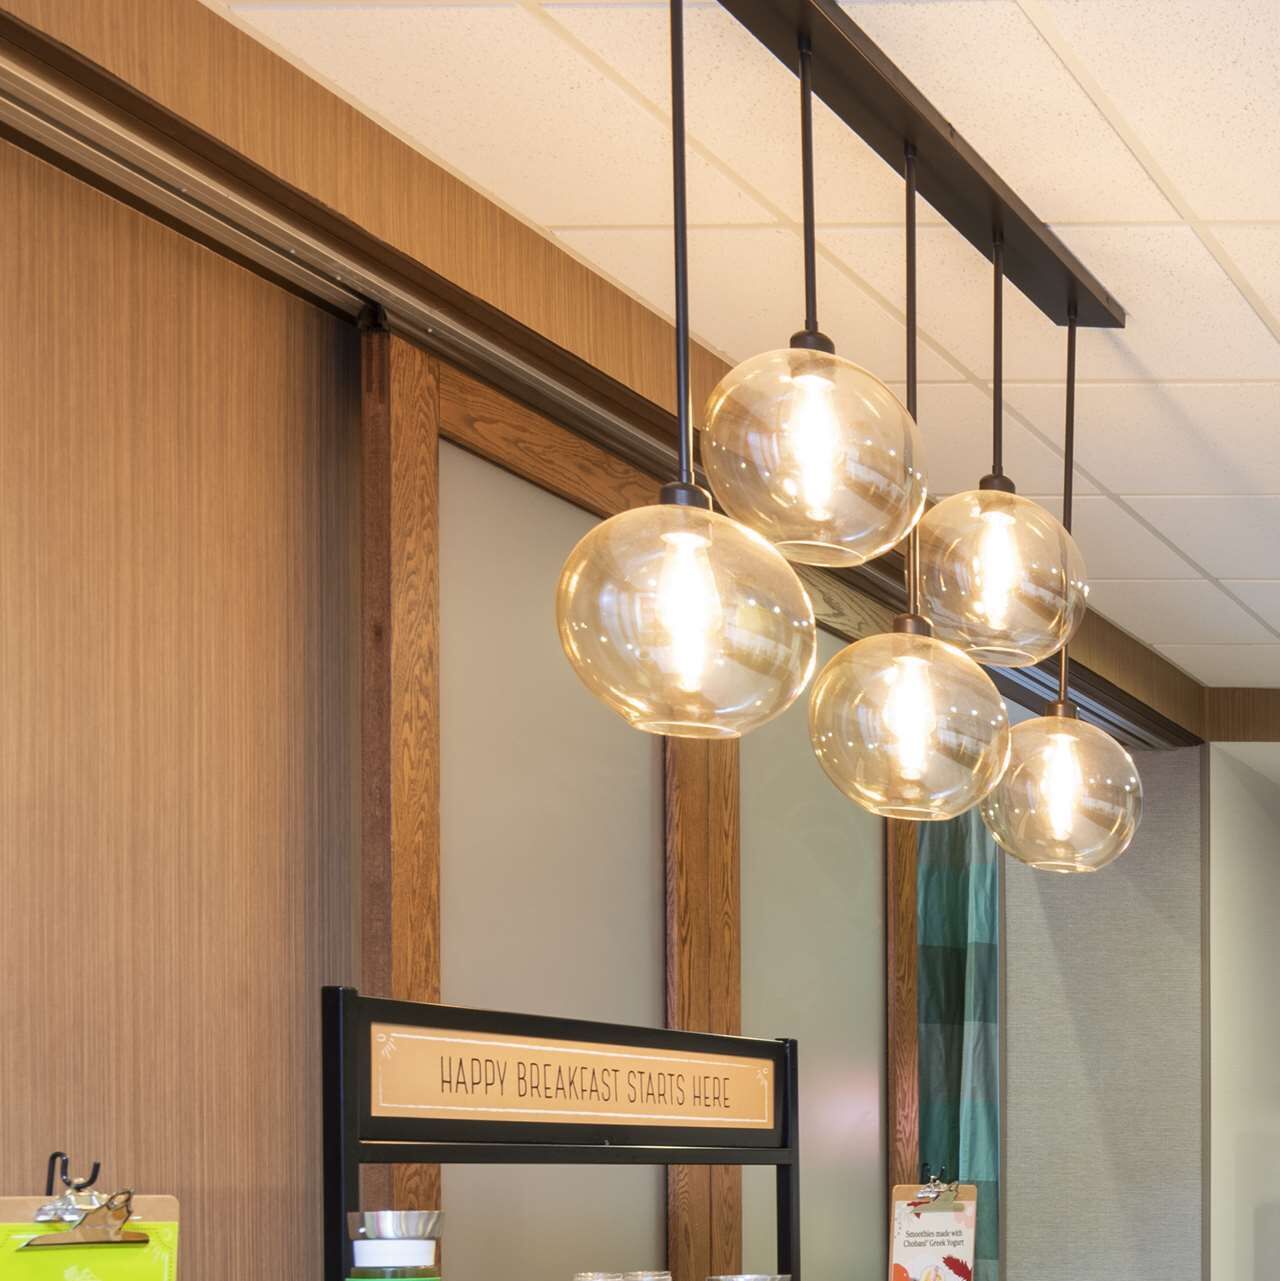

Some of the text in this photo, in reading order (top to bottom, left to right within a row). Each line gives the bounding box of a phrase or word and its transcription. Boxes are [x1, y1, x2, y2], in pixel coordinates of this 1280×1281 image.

[441, 1056, 731, 1108] HAPPY BREAKFAST STARTS HERE
[905, 1230, 935, 1238] Smoothies
[936, 1230, 949, 1238] made
[929, 1239, 946, 1247] Greek
[947, 1239, 965, 1248] Yogurt
